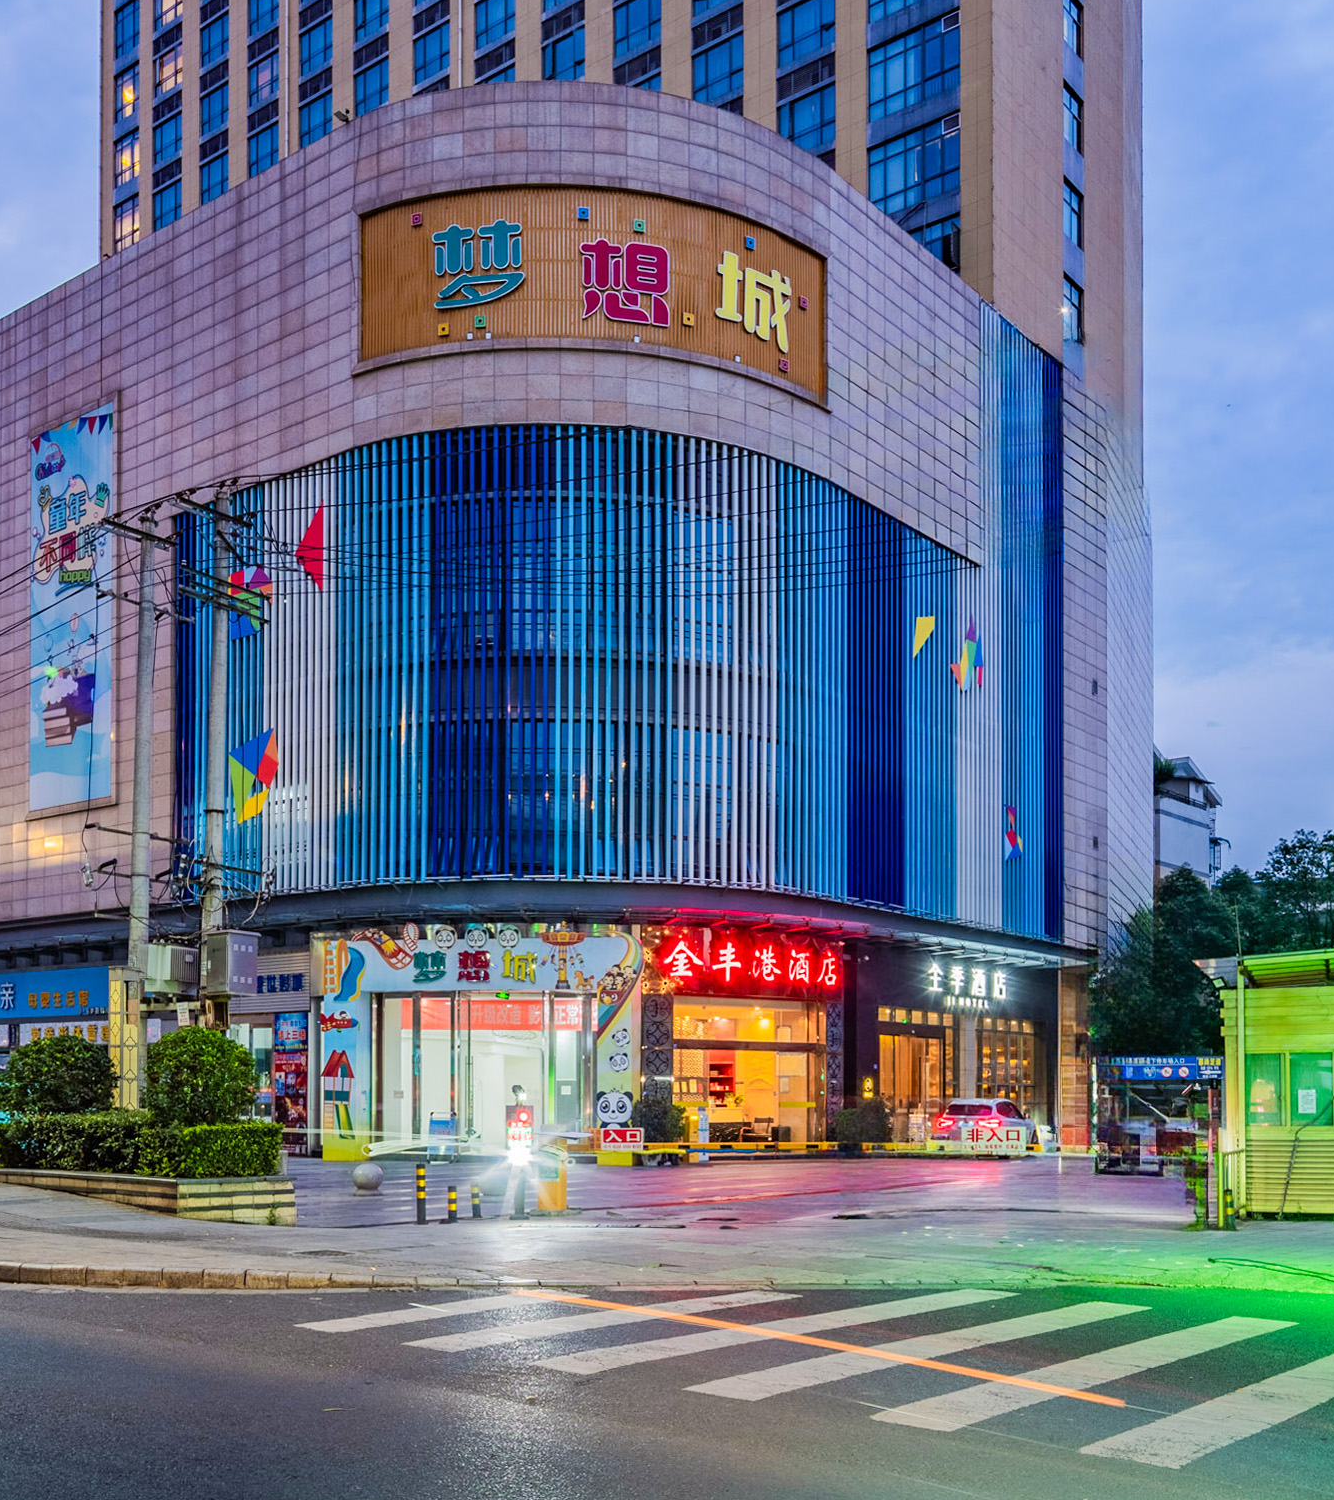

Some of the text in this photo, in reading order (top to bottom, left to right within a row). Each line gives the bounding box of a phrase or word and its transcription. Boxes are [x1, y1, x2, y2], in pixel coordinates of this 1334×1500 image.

[431, 218, 793, 354] 梦想城
[48, 490, 87, 535] 童年
[58, 568, 93, 584] happy
[412, 950, 538, 984] 梦想城
[663, 940, 839, 987] 金丰港酒店
[928, 962, 1007, 999] 全季酒店
[604, 1130, 642, 1143] 入口
[966, 1127, 1021, 1143] 非入口
